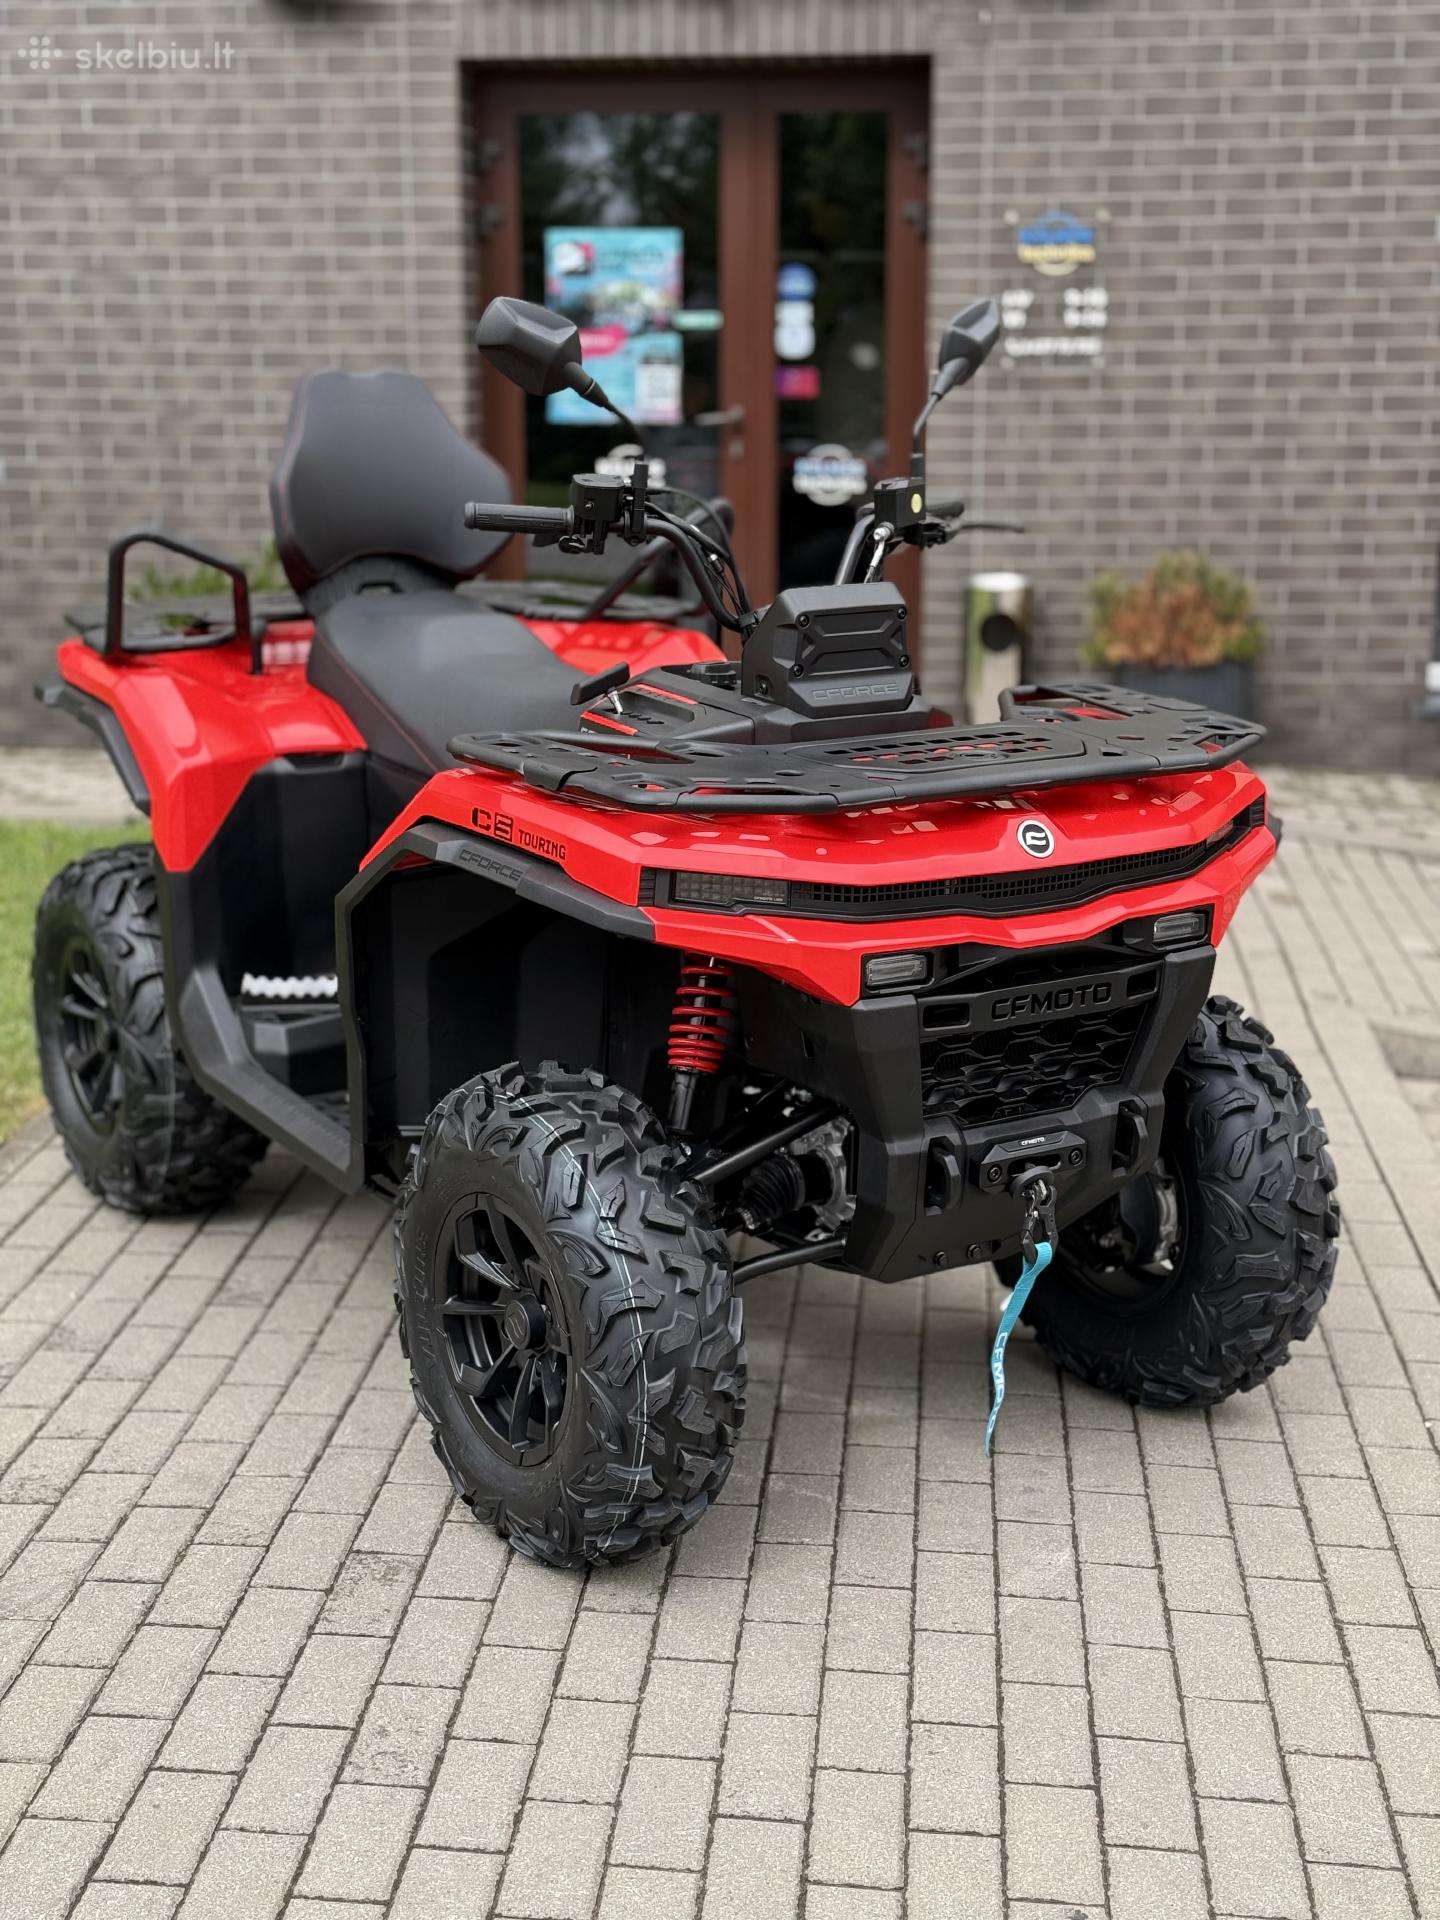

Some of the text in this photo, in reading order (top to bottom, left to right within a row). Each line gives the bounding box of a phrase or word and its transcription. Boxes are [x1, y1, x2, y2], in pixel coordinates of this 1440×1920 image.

[813, 683, 897, 700] CFORCE
[519, 829, 567, 860] TOURING
[459, 849, 523, 882] CFORCE
[991, 982, 1112, 1021] CFMOTO
